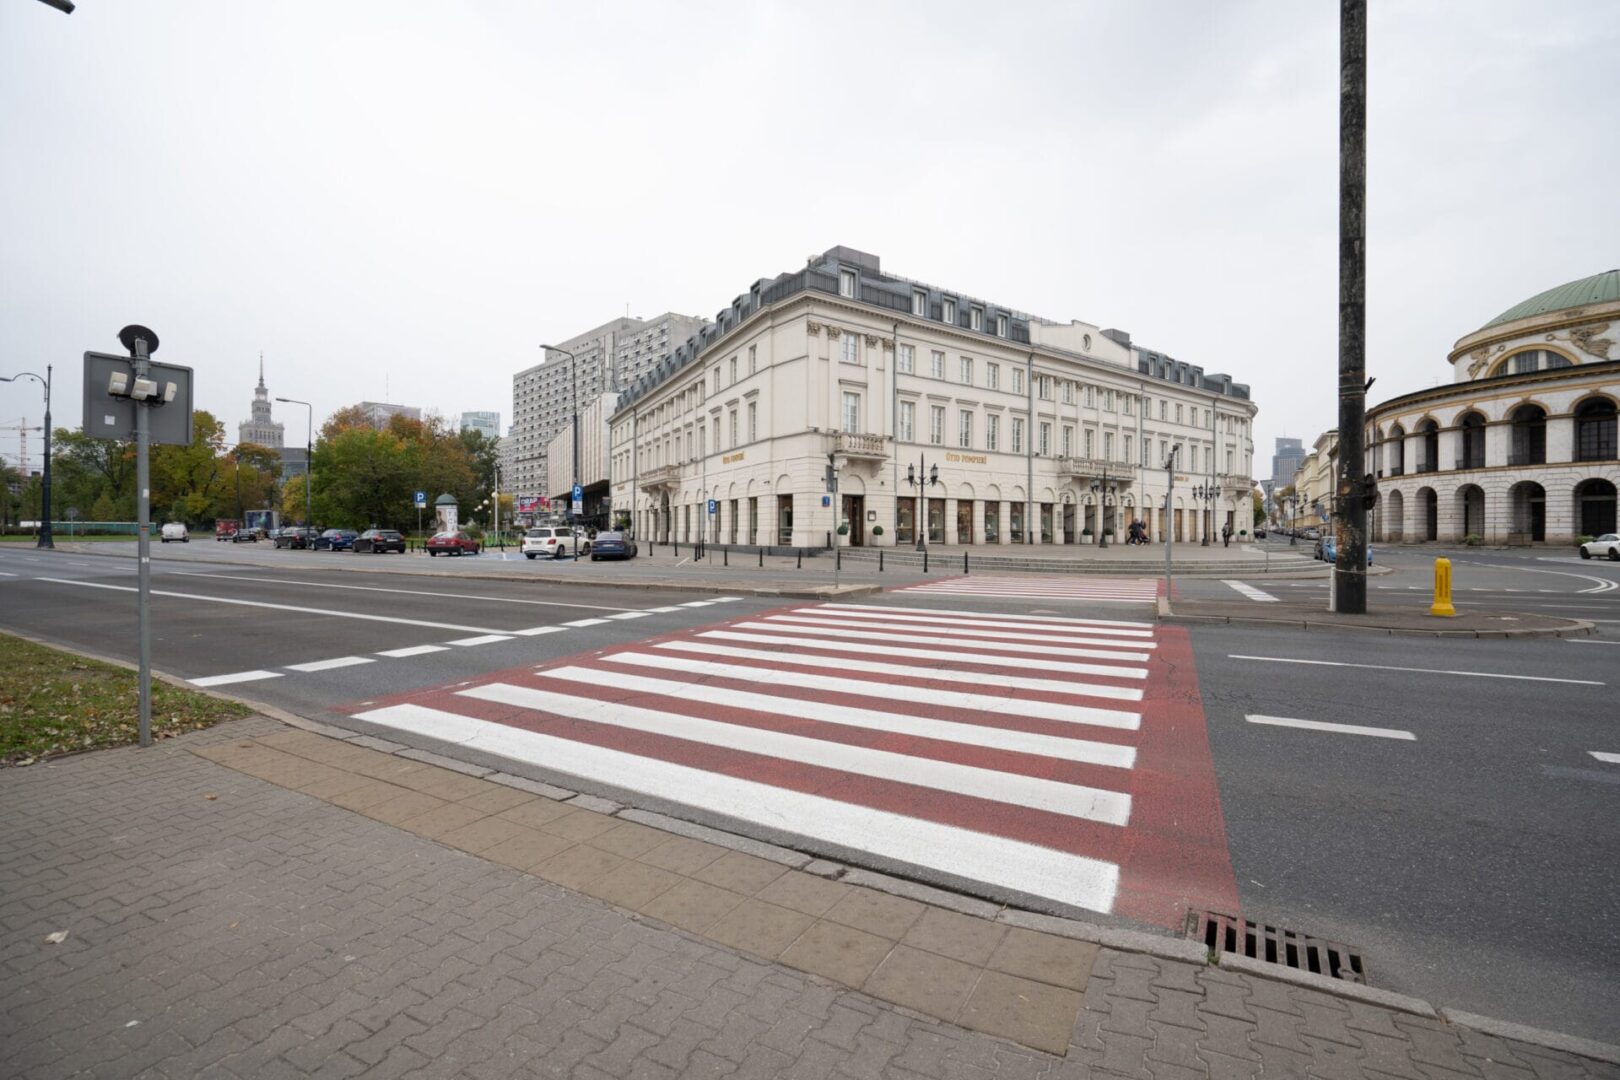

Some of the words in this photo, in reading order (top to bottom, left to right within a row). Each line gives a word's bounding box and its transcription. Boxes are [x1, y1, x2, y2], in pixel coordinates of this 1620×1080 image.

[417, 492, 424, 502] P
[574, 486, 581, 497] P
[710, 501, 715, 512] P
